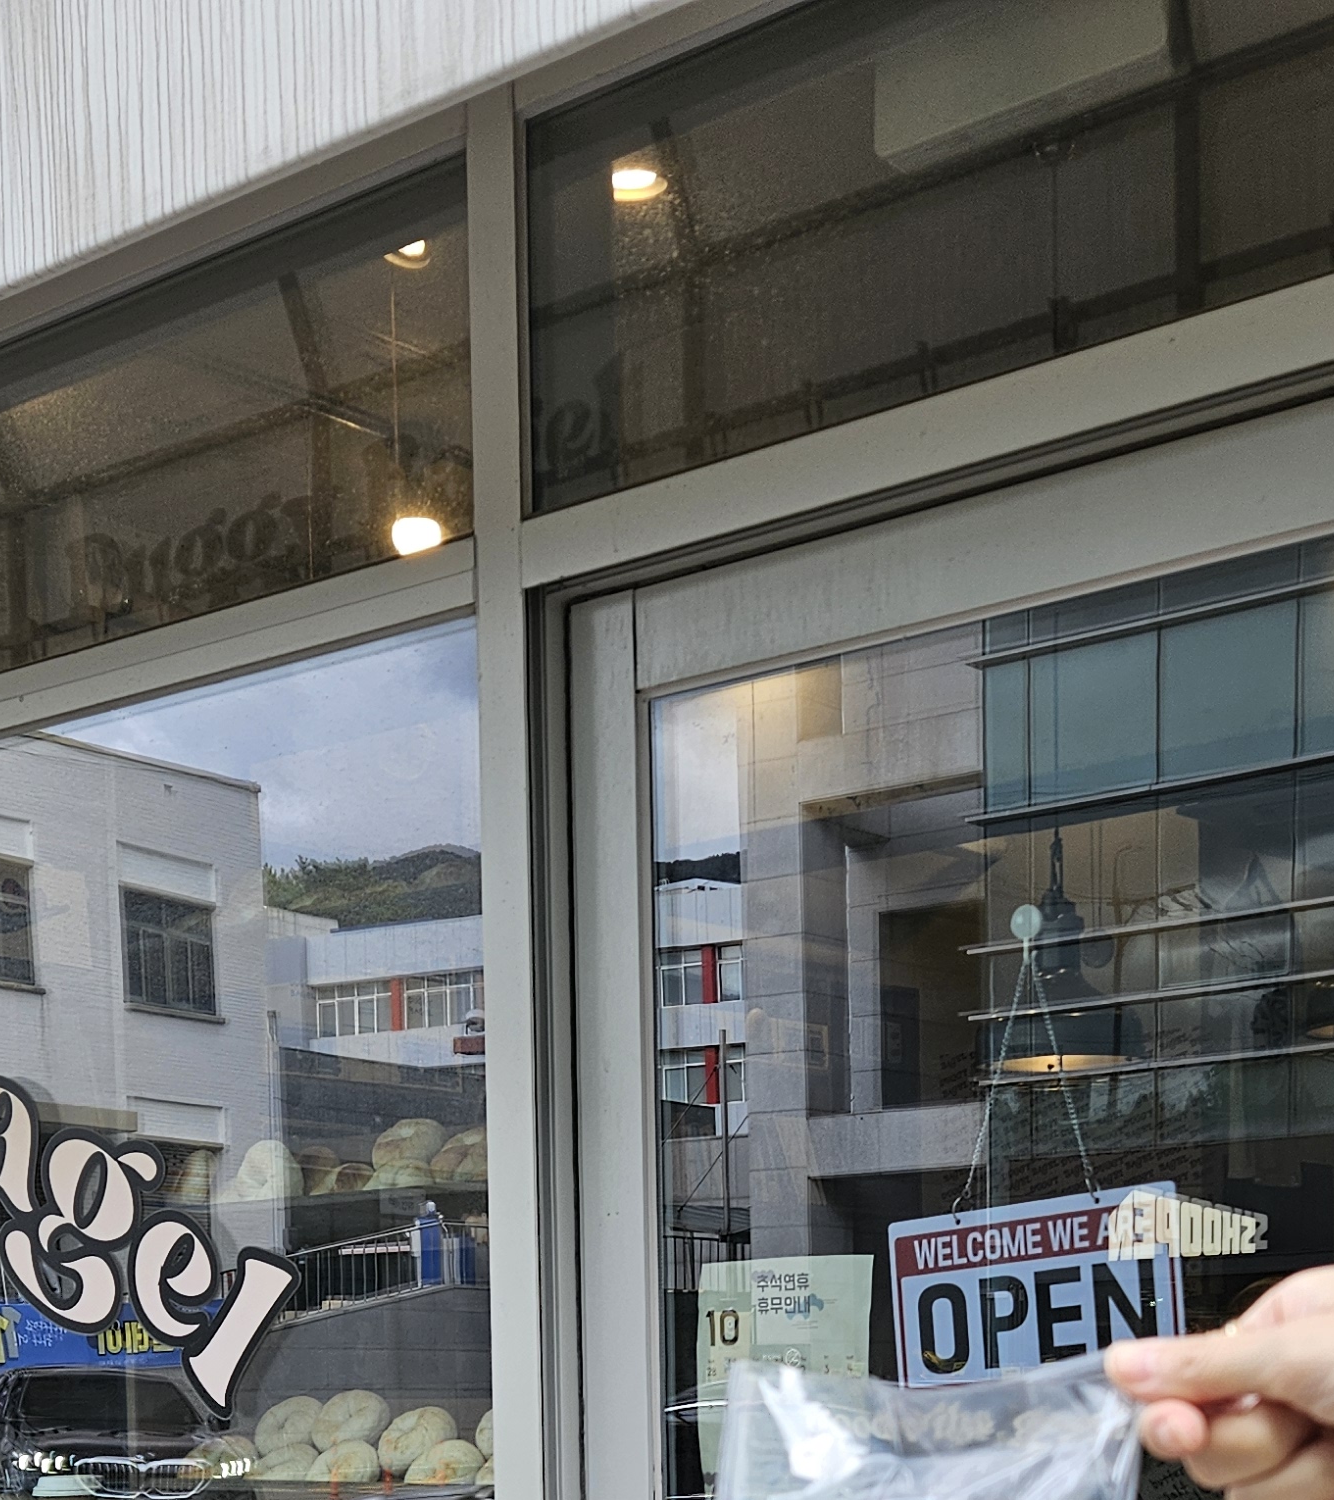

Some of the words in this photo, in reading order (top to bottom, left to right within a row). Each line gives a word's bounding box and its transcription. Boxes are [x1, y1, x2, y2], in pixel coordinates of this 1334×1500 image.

[914, 1223, 1042, 1270] WELCOME
[1048, 1216, 1089, 1251] WE
[757, 1272, 810, 1292] 추석연휴
[758, 1296, 811, 1315] 휴무안내
[918, 1259, 1158, 1374] OPEN
[706, 1309, 740, 1347] 10
